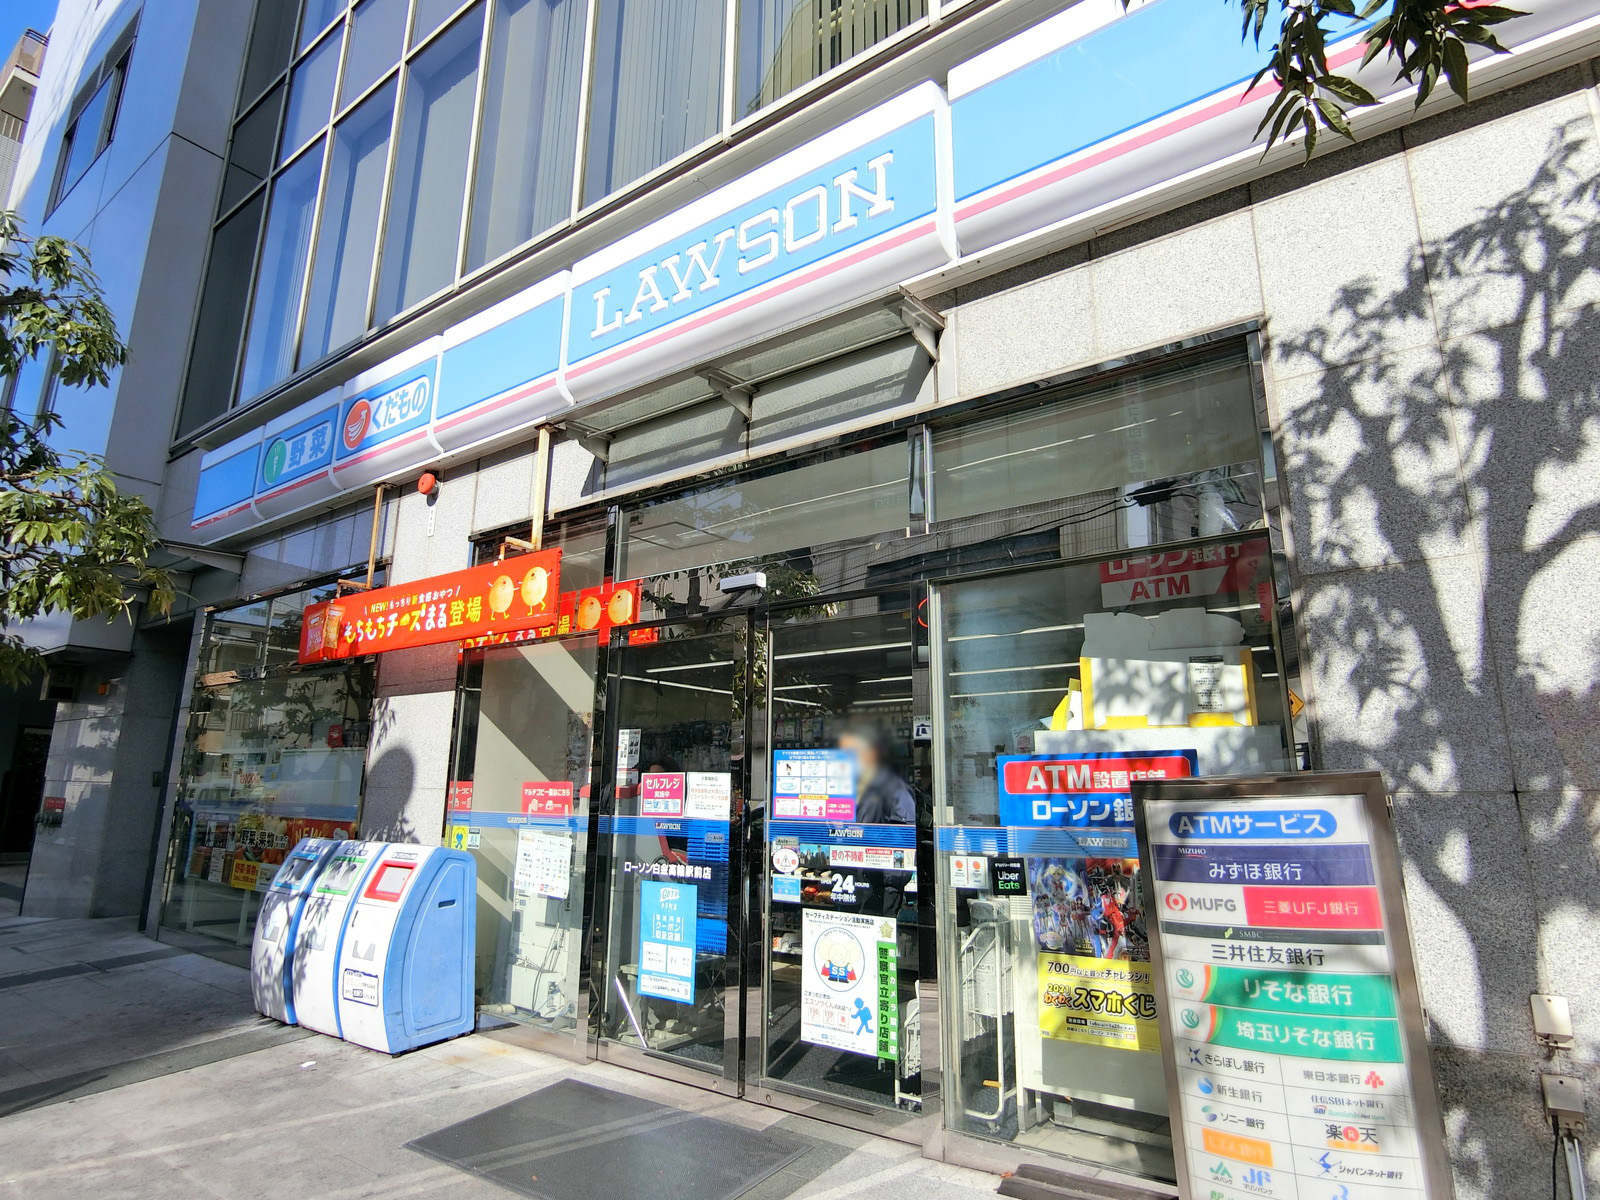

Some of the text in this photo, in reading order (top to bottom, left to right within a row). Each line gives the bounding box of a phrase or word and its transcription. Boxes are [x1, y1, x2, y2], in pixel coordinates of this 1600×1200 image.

[591, 150, 894, 339] LAWSON
[372, 387, 425, 430] くだもの
[290, 429, 331, 469] 野菜
[1130, 574, 1191, 601] ATM
[371, 601, 389, 613] NEW!
[344, 596, 482, 643] もちもちチーズまる登場
[646, 778, 680, 789] セルフレジ
[1177, 812, 1327, 836] ATMサービス
[829, 829, 864, 838] LAWSON
[1078, 836, 1129, 848] LAWSON
[1178, 847, 1207, 855] MIZUHO
[624, 861, 712, 880] ローソン白金高輪駅前店
[997, 871, 1020, 880] Uber
[1208, 861, 1303, 881] みずほ銀行
[831, 873, 855, 894] 24
[998, 881, 1020, 889] Eats
[1190, 896, 1237, 912] MUFG
[1263, 900, 1360, 916] 三菱UFJ銀行
[655, 920, 681, 932] クーポン
[1239, 929, 1263, 939] SMBC
[1211, 943, 1325, 966] 三井住友銀行
[831, 966, 845, 976] SS
[1047, 983, 1070, 993] 2021
[1243, 978, 1353, 1006] りそな銀行
[1043, 987, 1157, 1018] わくわく スマホくじ
[1236, 1020, 1375, 1051] 埼玉りそな銀行
[1204, 1053, 1265, 1074] きらぼし銀行
[1303, 1069, 1361, 1085] 東日本銀行
[1216, 1084, 1263, 1103] 新生銀行
[1310, 1094, 1385, 1109] 住信SBIネット銀行
[1313, 1107, 1326, 1115] SBI
[1220, 1112, 1265, 1130] ソニー銀行
[1212, 1174, 1233, 1185] JAバンク
[1339, 1165, 1403, 1180] ジャパンネット銀行
[1243, 1183, 1273, 1195] マリンバンク
